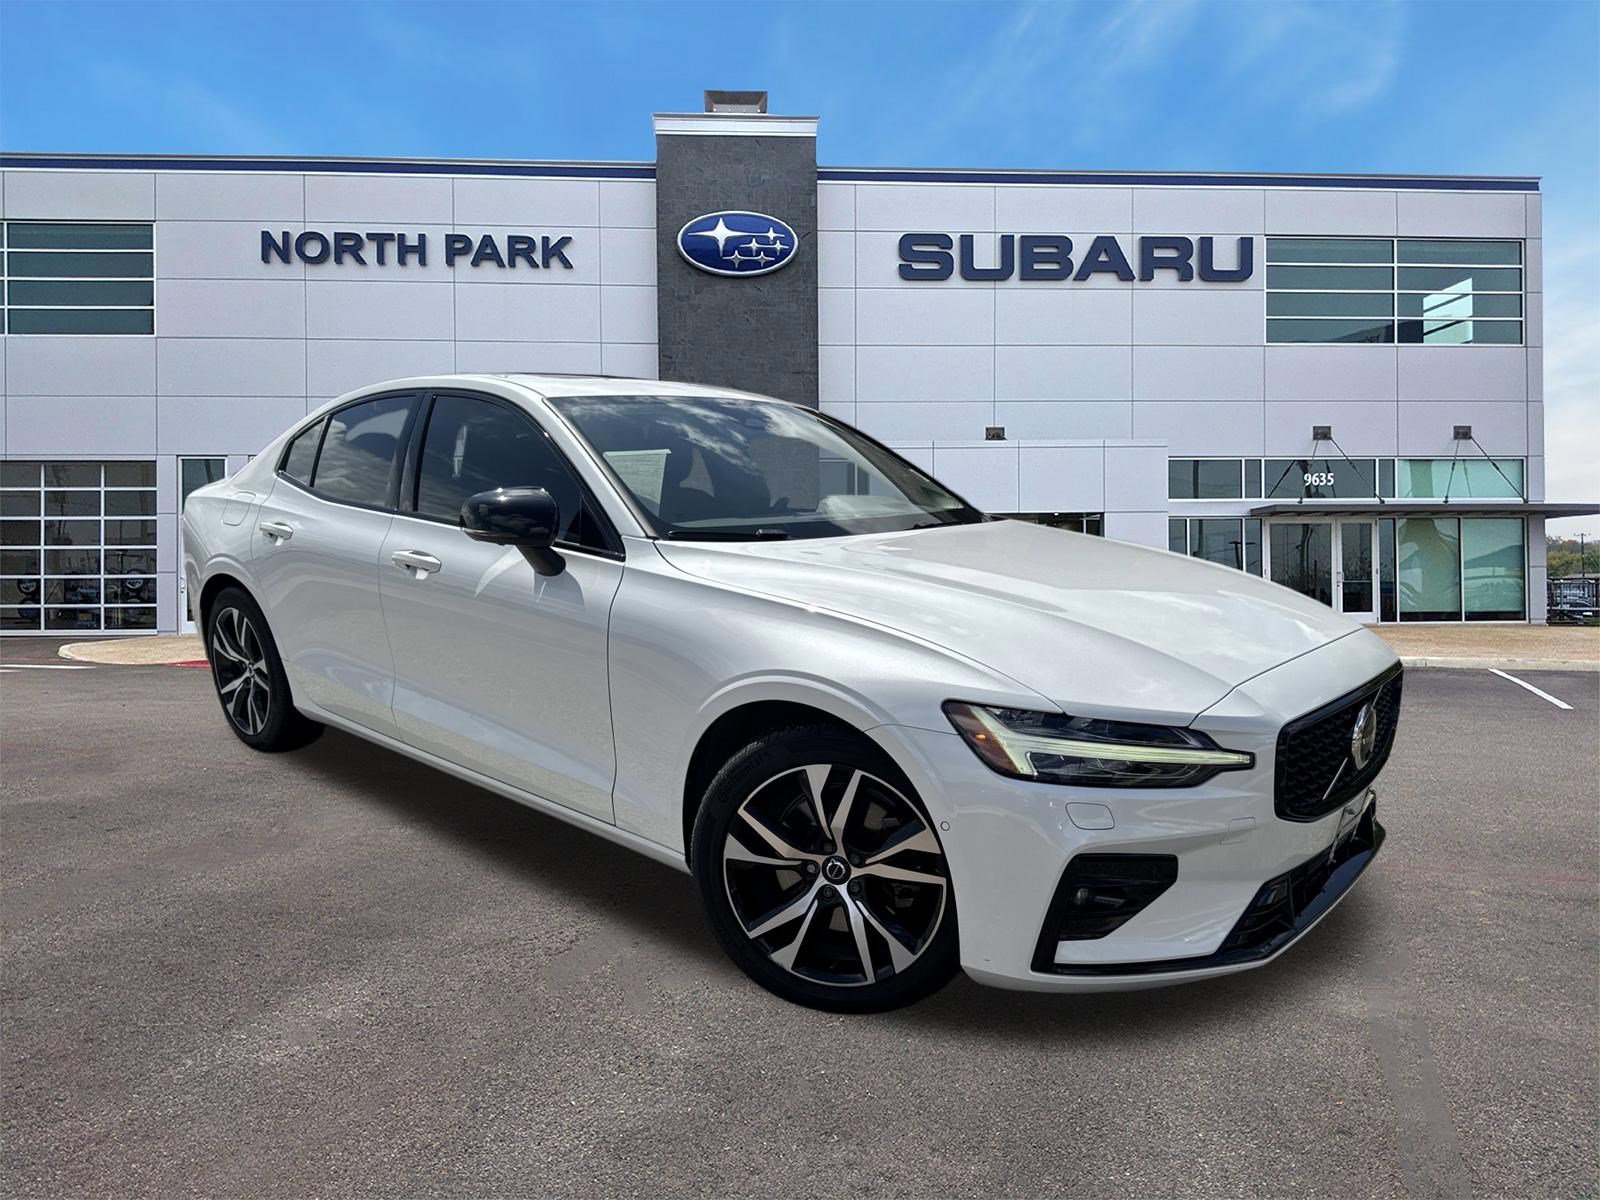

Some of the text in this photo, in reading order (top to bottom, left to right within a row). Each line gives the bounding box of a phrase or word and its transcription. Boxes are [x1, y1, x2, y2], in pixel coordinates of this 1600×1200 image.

[261, 230, 574, 270] NORTH PARK
[897, 233, 1254, 282] SUBARU
[1303, 472, 1335, 486] 9635
